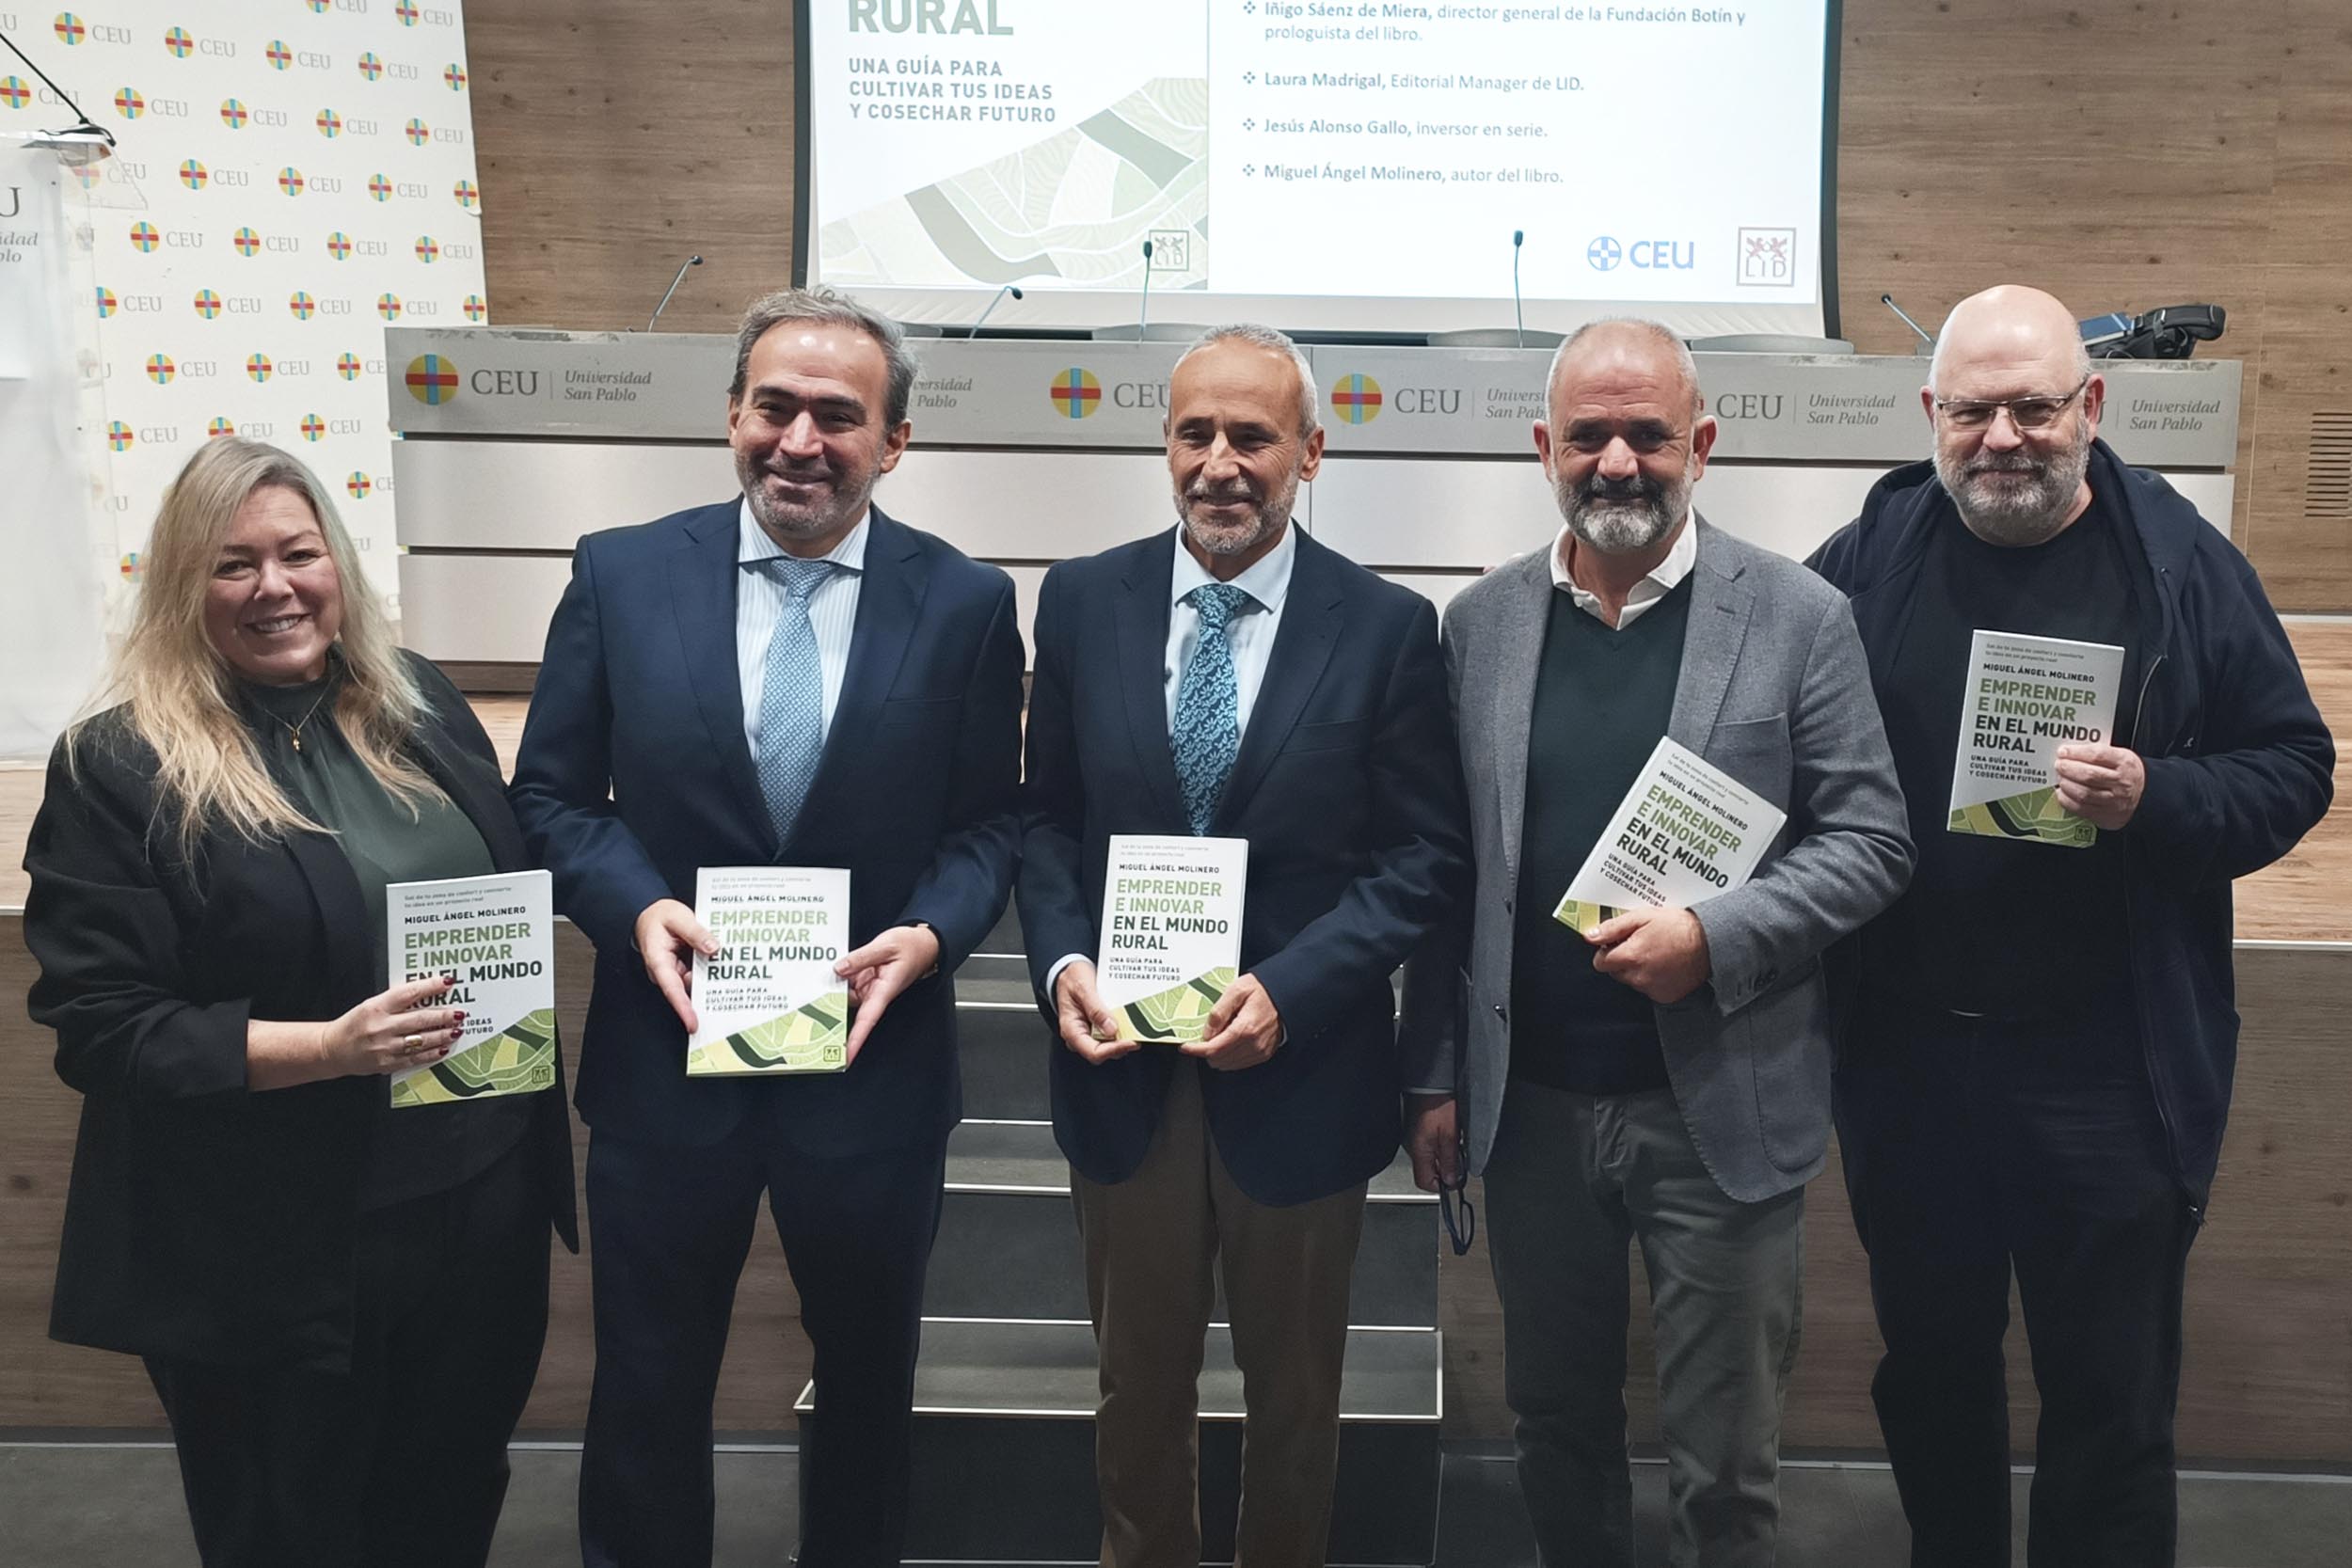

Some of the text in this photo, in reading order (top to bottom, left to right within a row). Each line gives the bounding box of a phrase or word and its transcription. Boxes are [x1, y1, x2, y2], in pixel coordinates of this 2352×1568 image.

[423, 9, 453, 26] CEU
[848, 0, 1014, 35] RURAL
[1308, 2, 1353, 16] Sáenz
[1358, 3, 1376, 17] de
[1383, 4, 1432, 20] Miera,
[1438, 5, 1497, 19] director
[1503, 6, 1559, 22] general
[1565, 7, 1583, 20] de
[1589, 7, 1601, 20] la
[1607, 8, 1686, 22] Fundación
[1692, 8, 1732, 23] Botín
[1737, 12, 1745, 26] y
[92, 25, 132, 45] CEU
[1265, 25, 1422, 41] prologuista del libro.
[199, 40, 236, 57] CEU
[298, 52, 331, 70] CEU
[849, 55, 1002, 76] UNA GUÍA PARA
[388, 63, 418, 80] CEU
[850, 81, 1052, 99] CULTIVAR TUS IDEAS
[1265, 72, 1584, 92] Laura Madrigal, Editorial Manager de LID.
[151, 99, 188, 118] CEU
[850, 103, 1056, 122] Y COSECHAR FUTURO
[253, 109, 288, 127] CEU
[346, 119, 378, 135] CEU
[434, 128, 464, 143] CEU
[1264, 119, 1548, 137] Jesús Alonso Gallo, inversor en serie.
[214, 169, 248, 187] CEU
[1264, 162, 1563, 184] Miguel Ángel Molinero, autor del libro.
[310, 177, 342, 193] CEU
[397, 183, 428, 198] CEU
[167, 231, 202, 247] CEU
[266, 237, 299, 253] CEU
[357, 241, 388, 256] CEU
[443, 245, 472, 259] CEU
[1630, 241, 1693, 269] CEU
[124, 296, 162, 313] CEU
[228, 298, 261, 313] CEU
[320, 300, 351, 314] CEU
[406, 301, 437, 315] CEU
[182, 361, 216, 377] CEU
[278, 361, 310, 375] CEU
[471, 370, 537, 395] CEU
[565, 370, 651, 386] Universidad
[564, 388, 636, 402] San Pablo
[917, 395, 957, 408] Pablo
[1395, 388, 1461, 414] CEU
[1808, 394, 1896, 408] Universidad
[1486, 406, 1512, 418] San
[1717, 394, 1783, 420] CEU
[2132, 399, 2221, 413] Universidad
[1807, 411, 1879, 425] San Pablo
[2130, 417, 2202, 430] San Pablo
[140, 427, 178, 443] CEU
[240, 422, 273, 438] CEU
[330, 420, 360, 434] CEU
[1983, 663, 2094, 682] MIGUEL ÁNGEL MOLINERO
[1980, 678, 2096, 706] EMPRENDER
[1978, 697, 2076, 721] E INNOVAR
[1976, 715, 2101, 743] EN EL MUNDO
[1973, 732, 2035, 753] RURAL
[1659, 770, 1686, 792] MIGUEL
[1687, 786, 1710, 808] ÁNGEL
[1712, 804, 1748, 831] MOLINERO
[1647, 784, 1741, 853] EMPRENDER
[1637, 801, 1717, 860] E INNOVAR
[1617, 833, 1667, 875] RURAL
[1627, 817, 1729, 888] EN EL MUNDO
[1604, 861, 1633, 881] CULTIVAR
[1117, 879, 1221, 897] EMPRENDER
[1115, 897, 1204, 914] E INNOVAR
[405, 906, 526, 925] MIGUEL ÁNGEL MOLINERO
[710, 910, 827, 926] EMPRENDER
[1114, 916, 1228, 934] EN EL MUNDO
[405, 922, 531, 950] EMPRENDER
[726, 928, 810, 943] INNOVAR
[1112, 934, 1168, 950] RURAL
[405, 944, 512, 969] E INNOVAR
[708, 947, 837, 962] EN EL MUNDO
[440, 968, 464, 983] EL
[470, 960, 542, 982] MUNDO
[707, 965, 772, 980] RURAL
